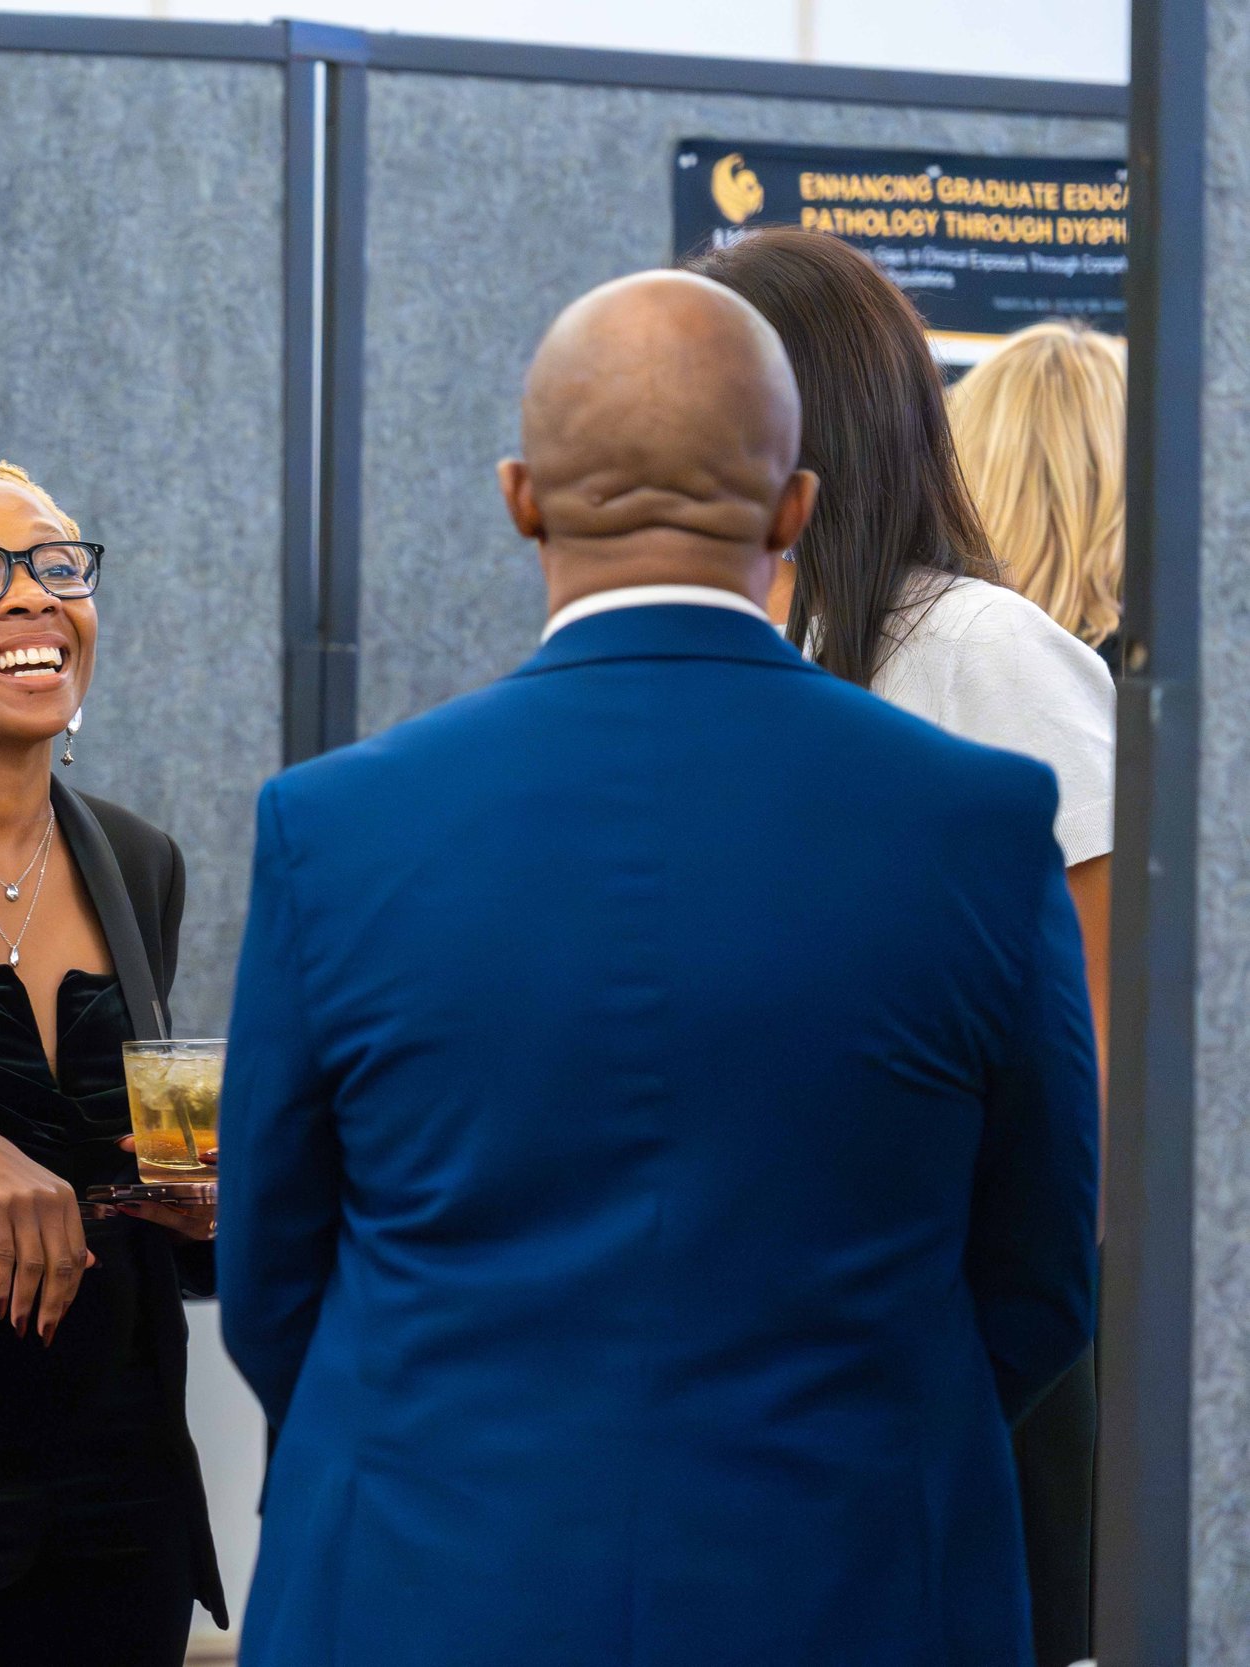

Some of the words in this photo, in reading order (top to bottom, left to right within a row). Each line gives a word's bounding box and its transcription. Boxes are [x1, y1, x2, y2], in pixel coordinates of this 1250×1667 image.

[799, 172, 934, 202] ENHANCING
[936, 175, 1060, 211] GRADUATE
[800, 206, 941, 237] PATHOLOGY
[942, 210, 1054, 244] THROUGH
